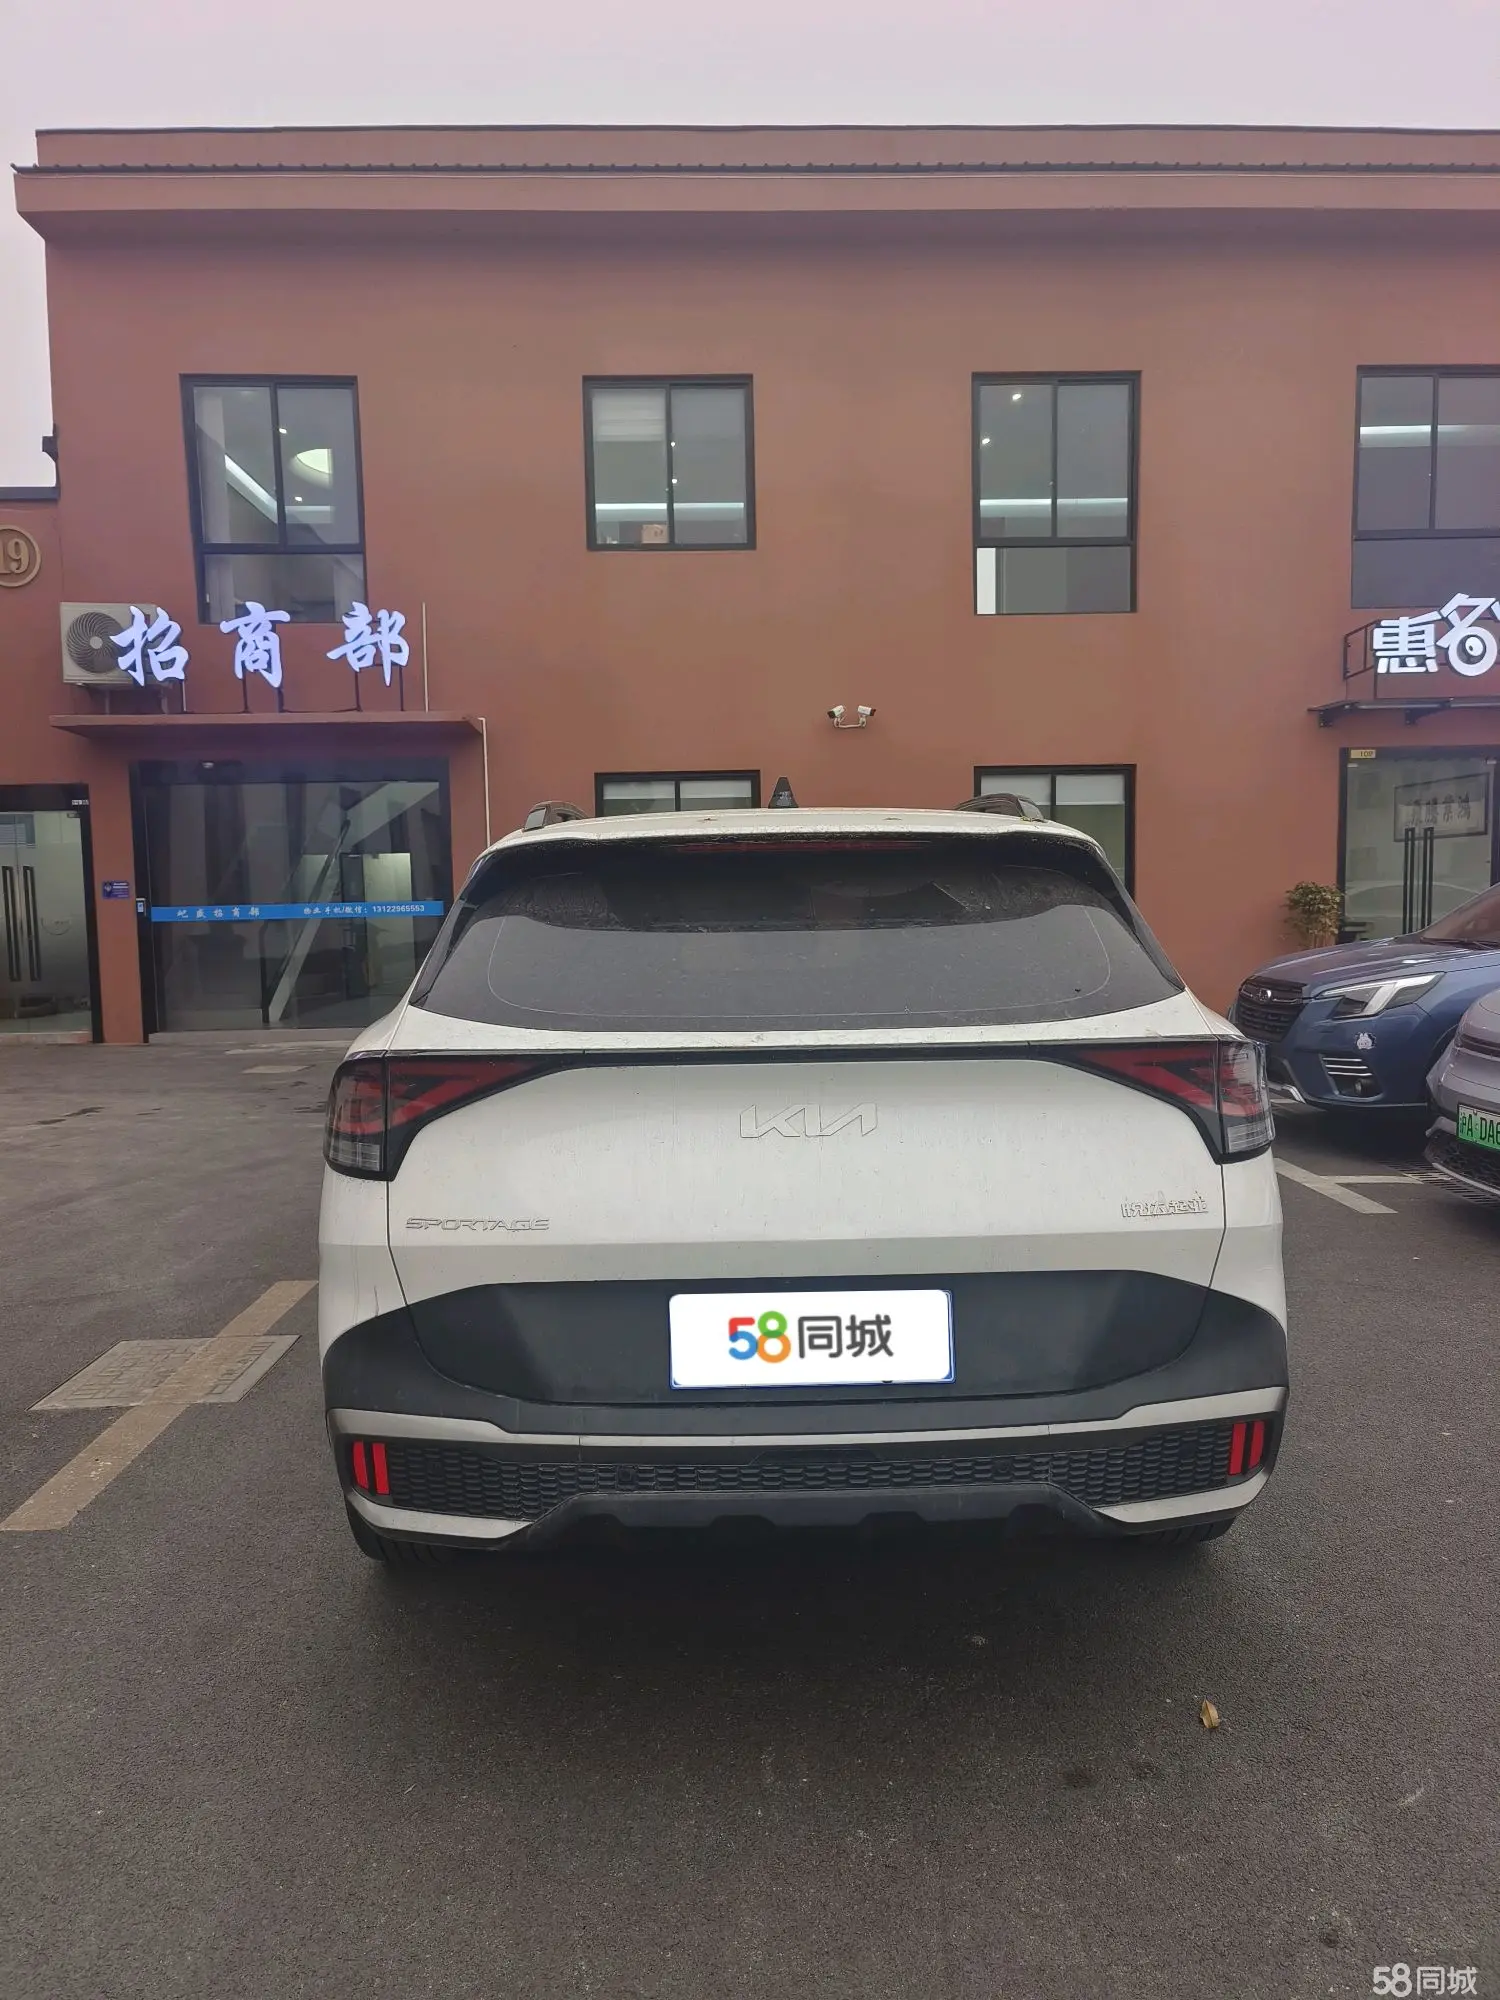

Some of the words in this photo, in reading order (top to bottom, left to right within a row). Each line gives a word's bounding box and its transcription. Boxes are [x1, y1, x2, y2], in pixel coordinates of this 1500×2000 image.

[109, 601, 410, 689] 招商部
[1373, 592, 1500, 677] 惠名
[739, 1102, 878, 1139] KIA
[405, 1217, 550, 1231] SPORTAGE
